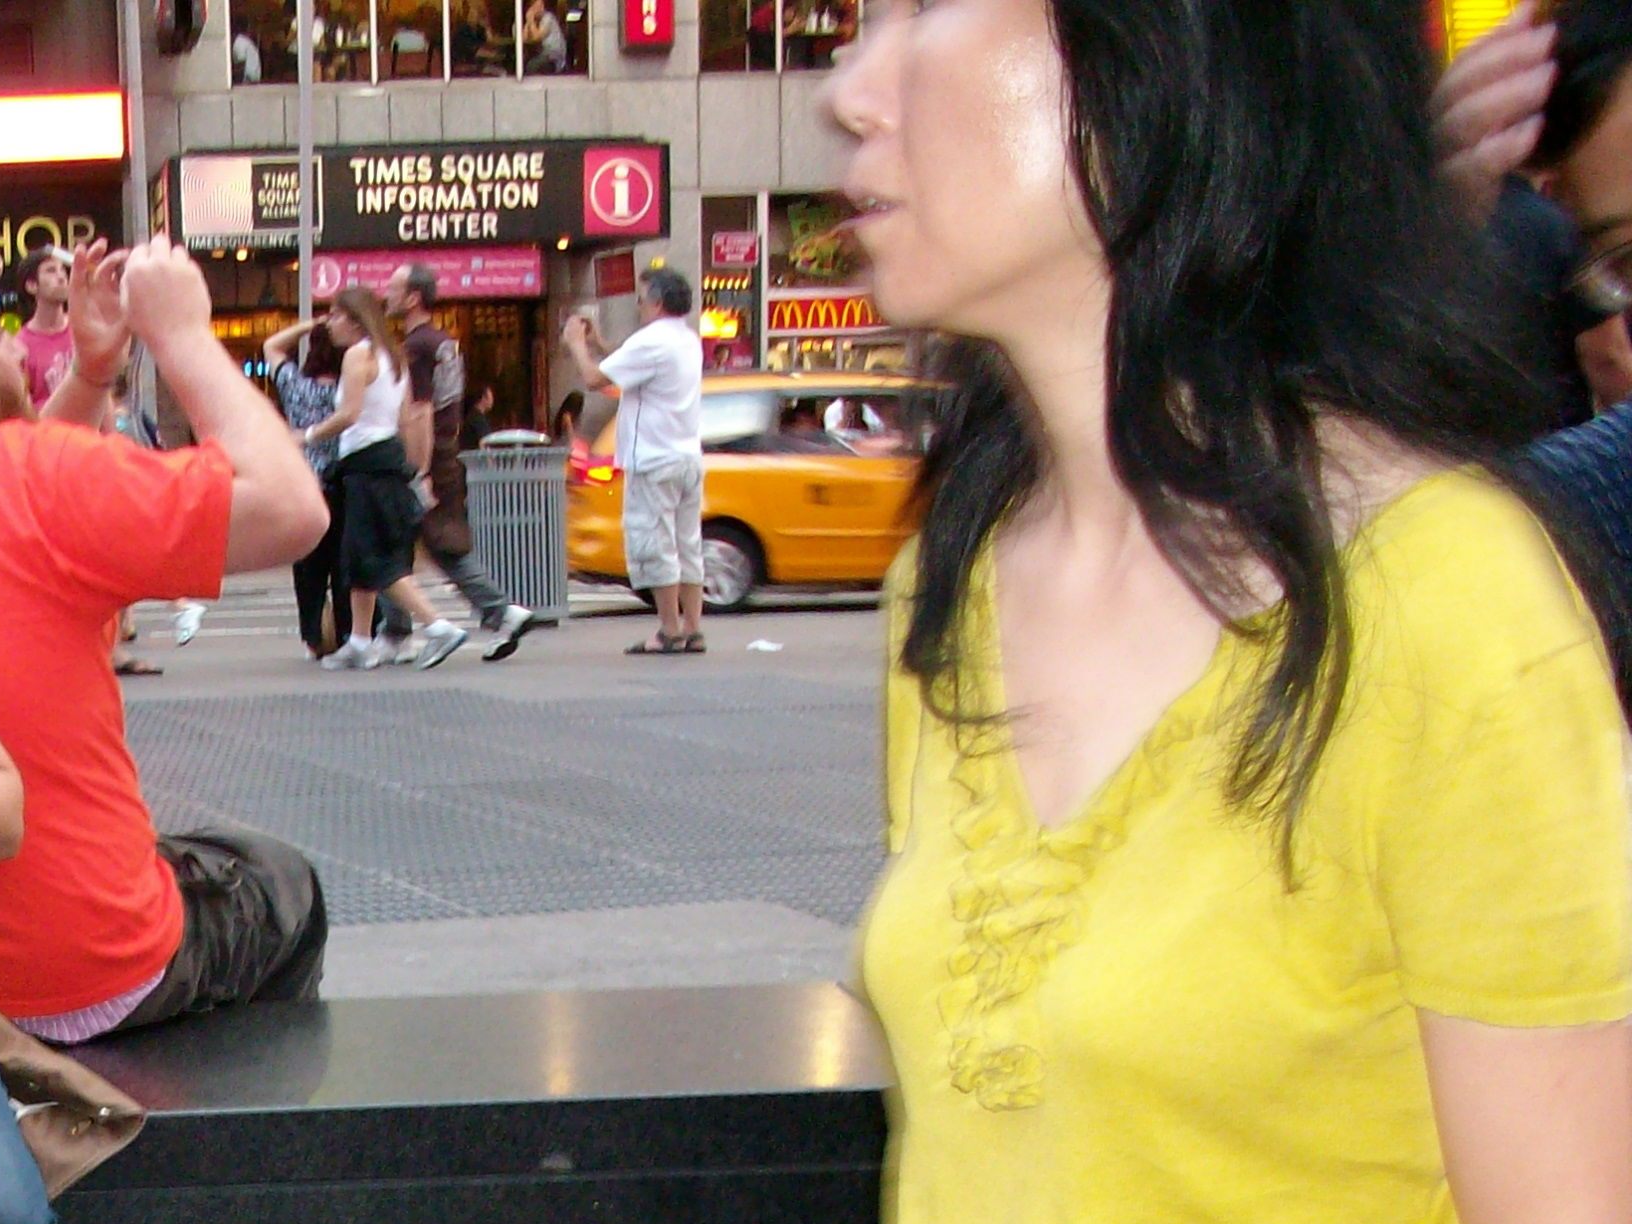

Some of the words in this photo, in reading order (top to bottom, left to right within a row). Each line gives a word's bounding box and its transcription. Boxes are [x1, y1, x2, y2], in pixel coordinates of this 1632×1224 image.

[262, 171, 300, 190] TIME
[350, 155, 433, 185] TIMES
[441, 152, 545, 187] SQUARE
[258, 188, 301, 208] SQUA
[356, 181, 540, 215] INFORMATION
[262, 204, 302, 219] ALLIAN
[398, 212, 499, 242] CENTER
